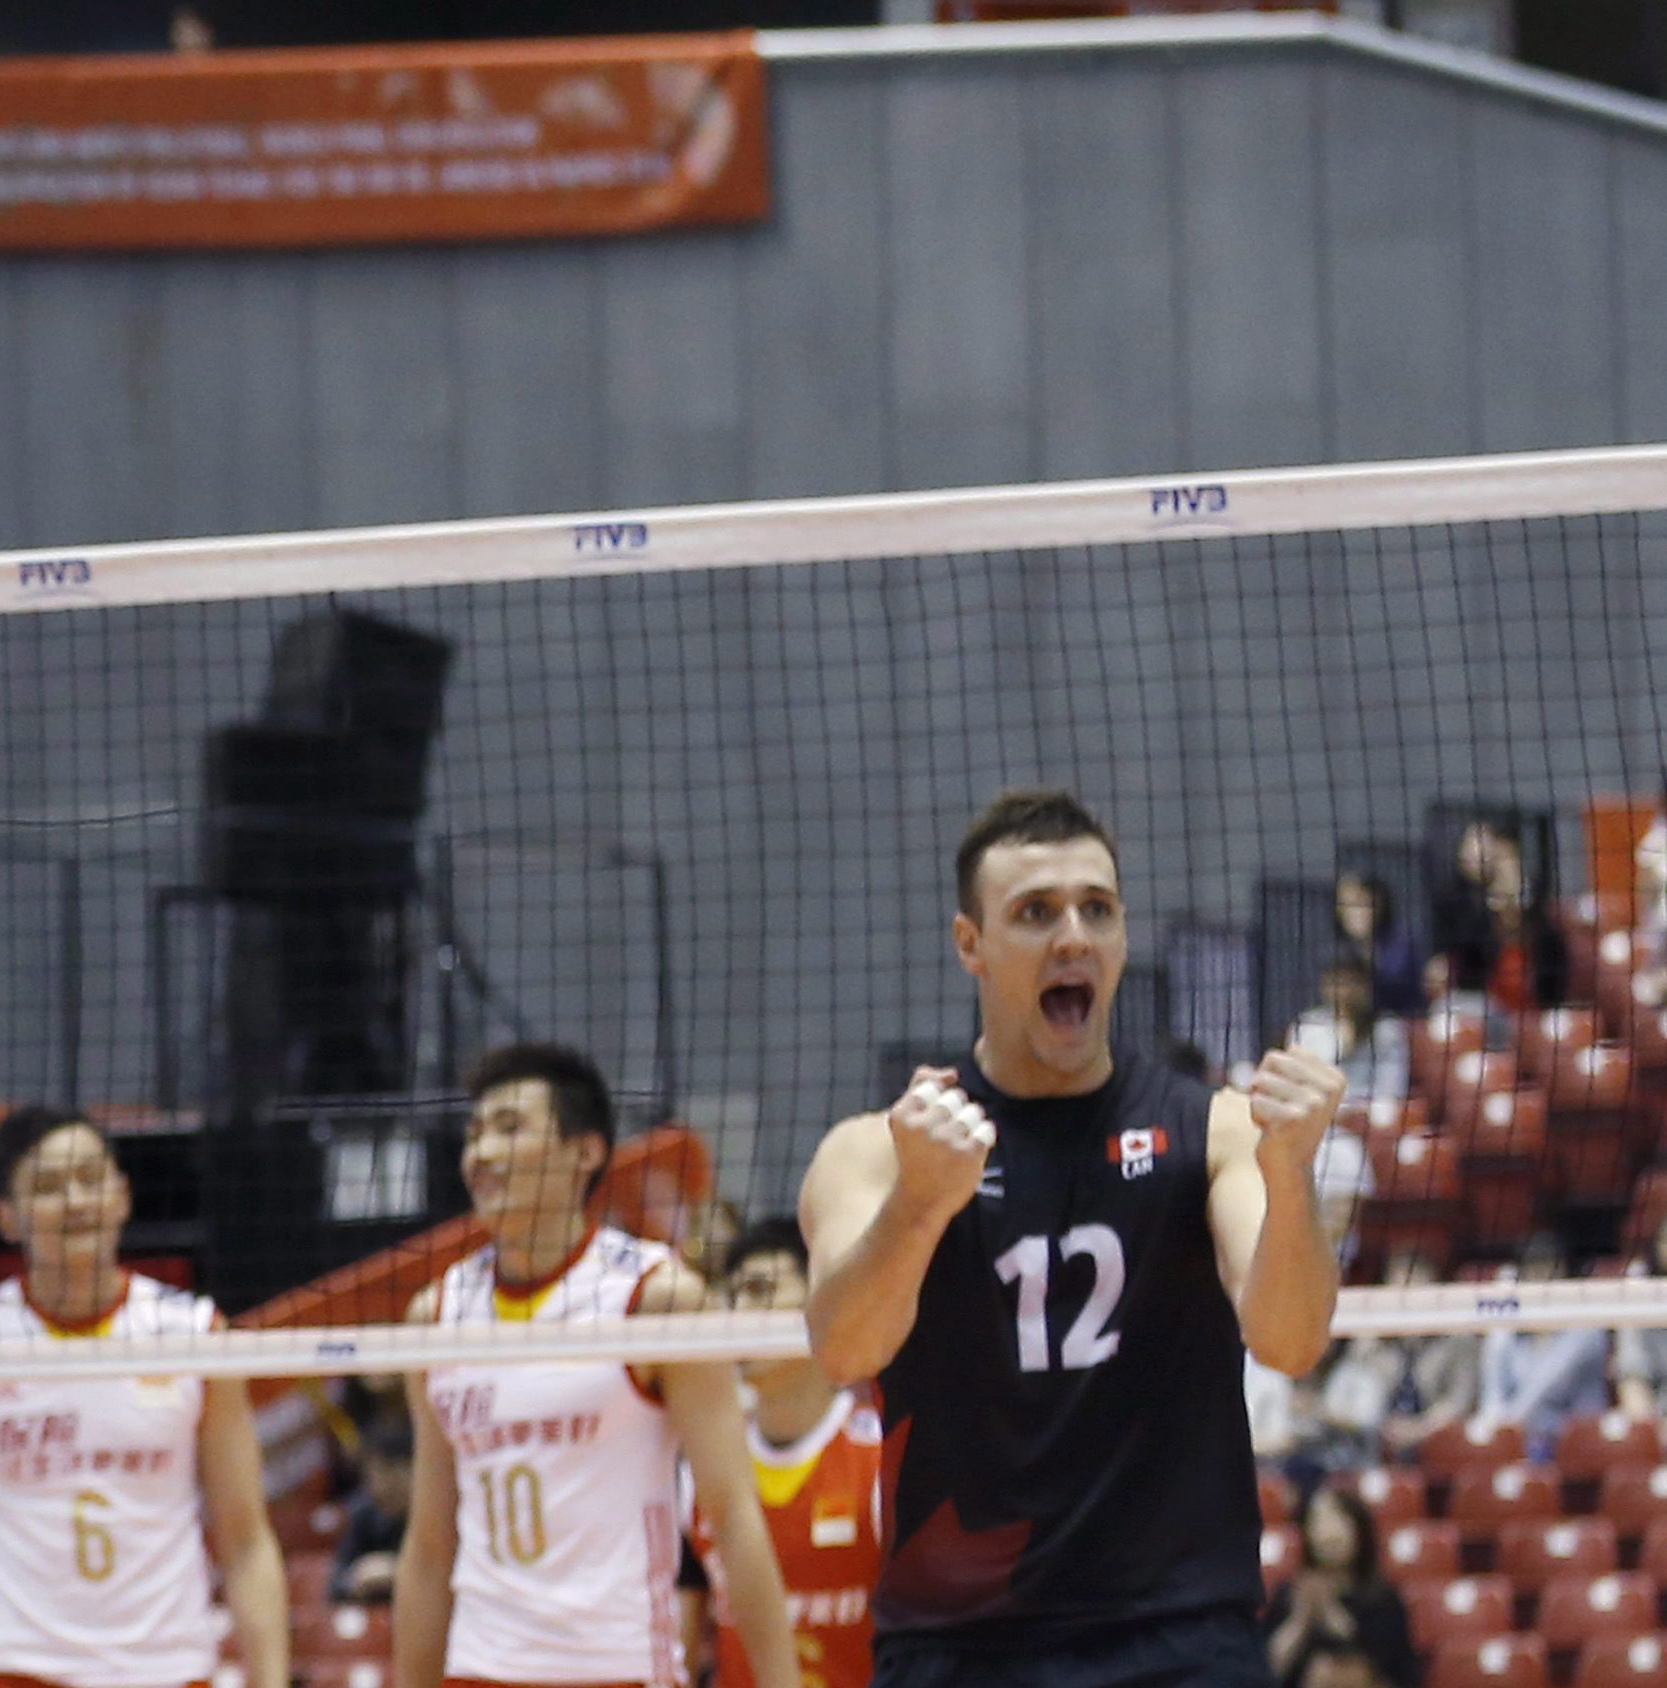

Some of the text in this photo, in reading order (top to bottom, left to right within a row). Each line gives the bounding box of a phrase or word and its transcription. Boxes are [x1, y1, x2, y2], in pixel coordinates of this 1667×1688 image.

[993, 1222, 1126, 1374] 12
[72, 1489, 117, 1582] 6
[478, 1463, 548, 1566] 10
